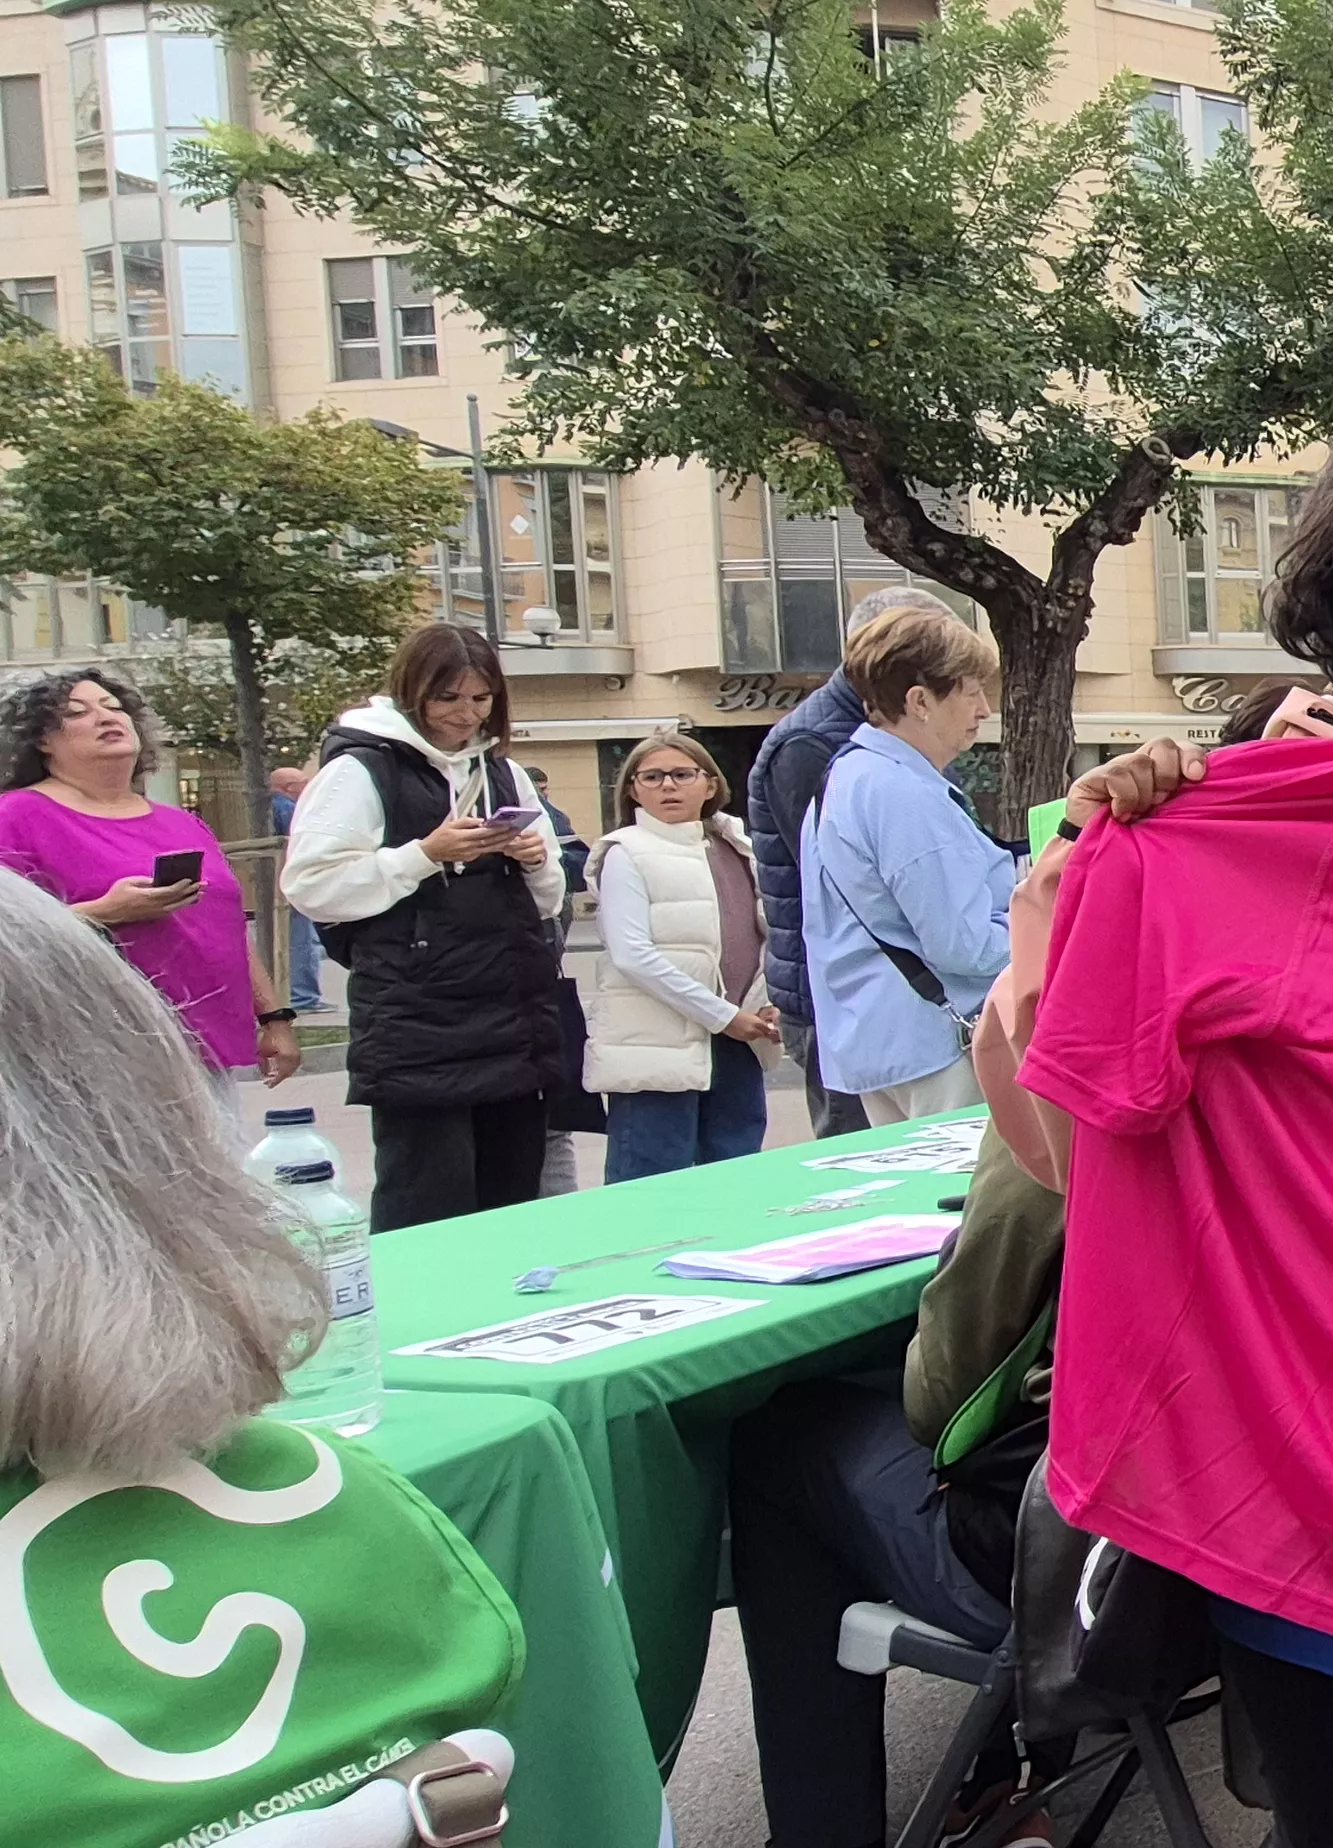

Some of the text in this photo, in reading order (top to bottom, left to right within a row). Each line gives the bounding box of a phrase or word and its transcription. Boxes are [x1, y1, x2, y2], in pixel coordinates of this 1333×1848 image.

[504, 1308, 685, 1345] 772
[253, 1773, 345, 1821] CONTRA
[338, 1763, 368, 1784] EL
